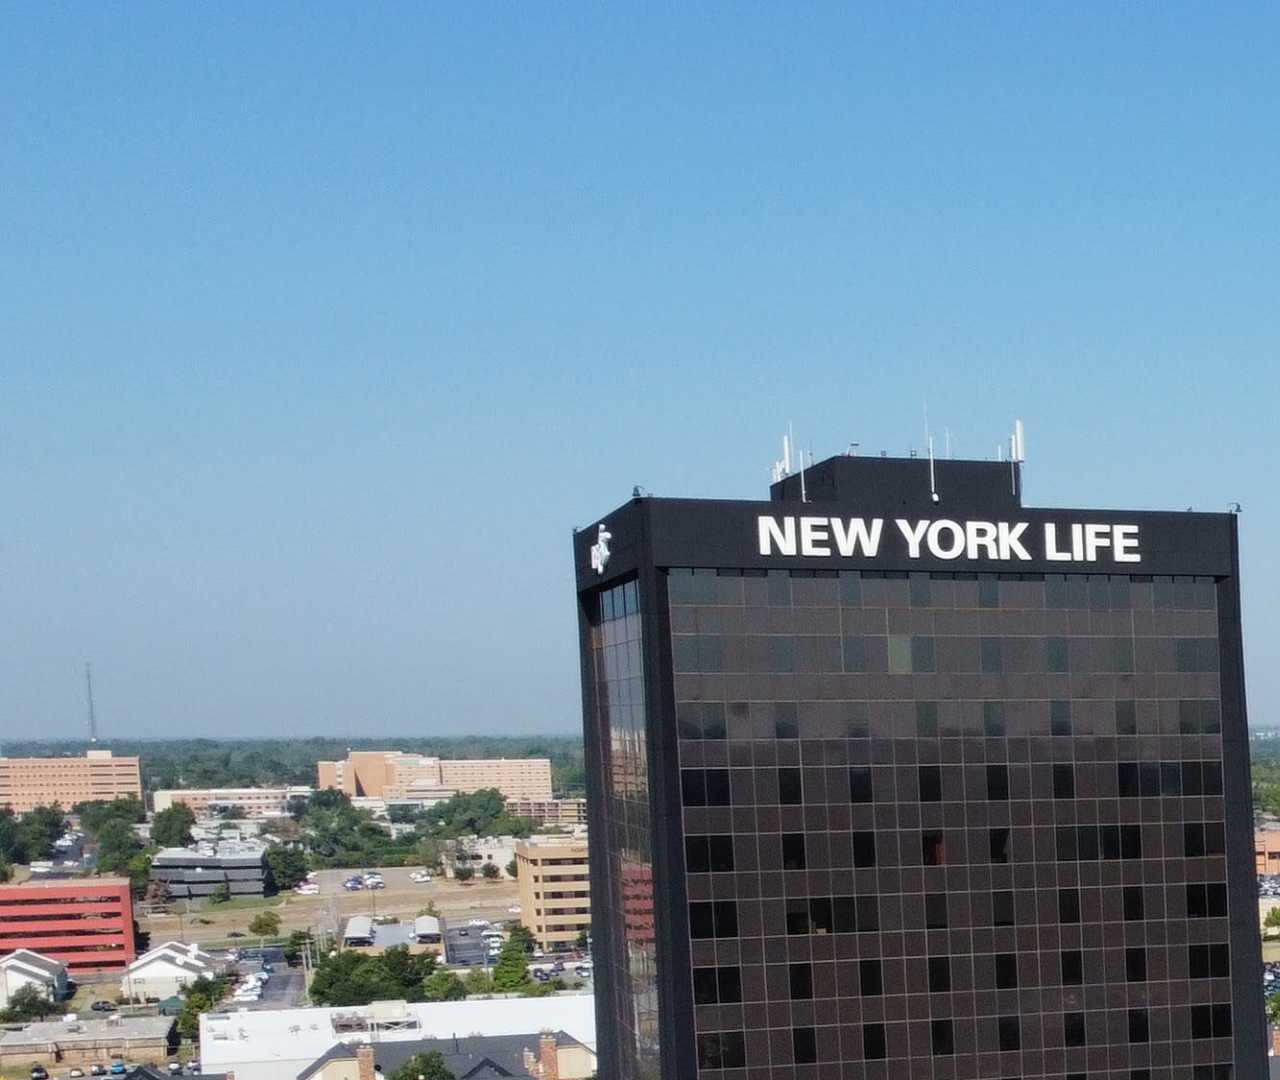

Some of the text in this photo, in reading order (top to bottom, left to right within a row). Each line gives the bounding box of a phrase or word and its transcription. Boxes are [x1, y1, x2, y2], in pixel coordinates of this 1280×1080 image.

[758, 516, 1141, 562] NEW YORK LIFE
